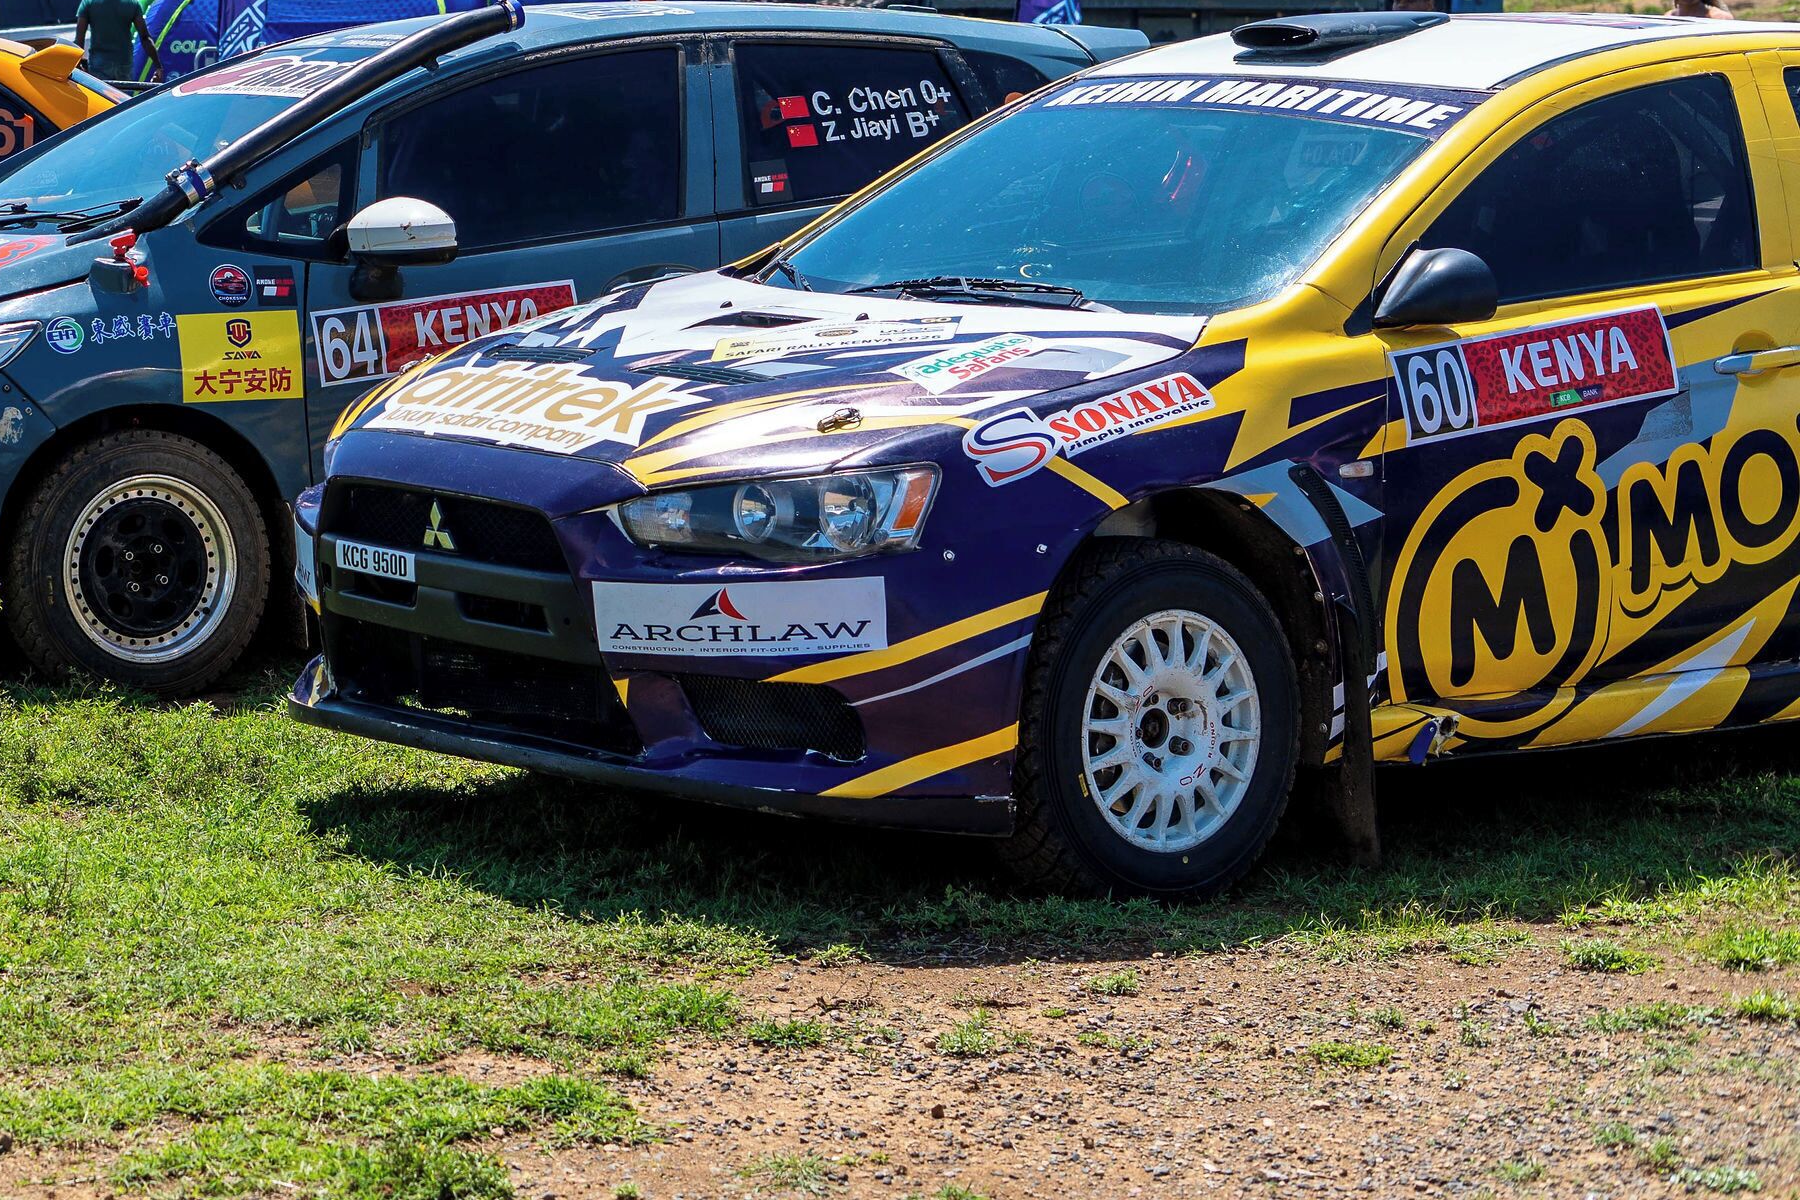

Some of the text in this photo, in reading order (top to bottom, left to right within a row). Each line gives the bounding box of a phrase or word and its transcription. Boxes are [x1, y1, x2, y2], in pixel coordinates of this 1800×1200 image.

[170, 40, 207, 53] GOLF
[812, 90, 842, 115] C.
[848, 86, 914, 113] Chen
[1042, 80, 1463, 130] KEIHIN MARITIME
[821, 109, 940, 142] Z. Jiayi B+
[90, 312, 177, 345] 東盛賽車
[414, 298, 538, 347] KENYA
[322, 312, 378, 379] 64
[725, 334, 941, 358] SAFARI RALLY KENYA 2026
[915, 336, 1029, 375] adequate
[947, 345, 1032, 381] Safaris
[1499, 326, 1639, 394] KENYA
[194, 367, 293, 396] 大宁安防
[397, 362, 680, 434] afritrek
[1408, 350, 1470, 434] 60
[1582, 388, 1599, 398] BANK
[384, 406, 598, 446] luxury safari company
[1049, 376, 1207, 443] SONAYA
[1069, 399, 1211, 452] simply innovative
[342, 544, 408, 577] KCG 950D
[609, 620, 872, 643] ARCHLAW
[611, 644, 686, 653] CONSTRUCTION
[816, 642, 871, 651] SUPPLIES
